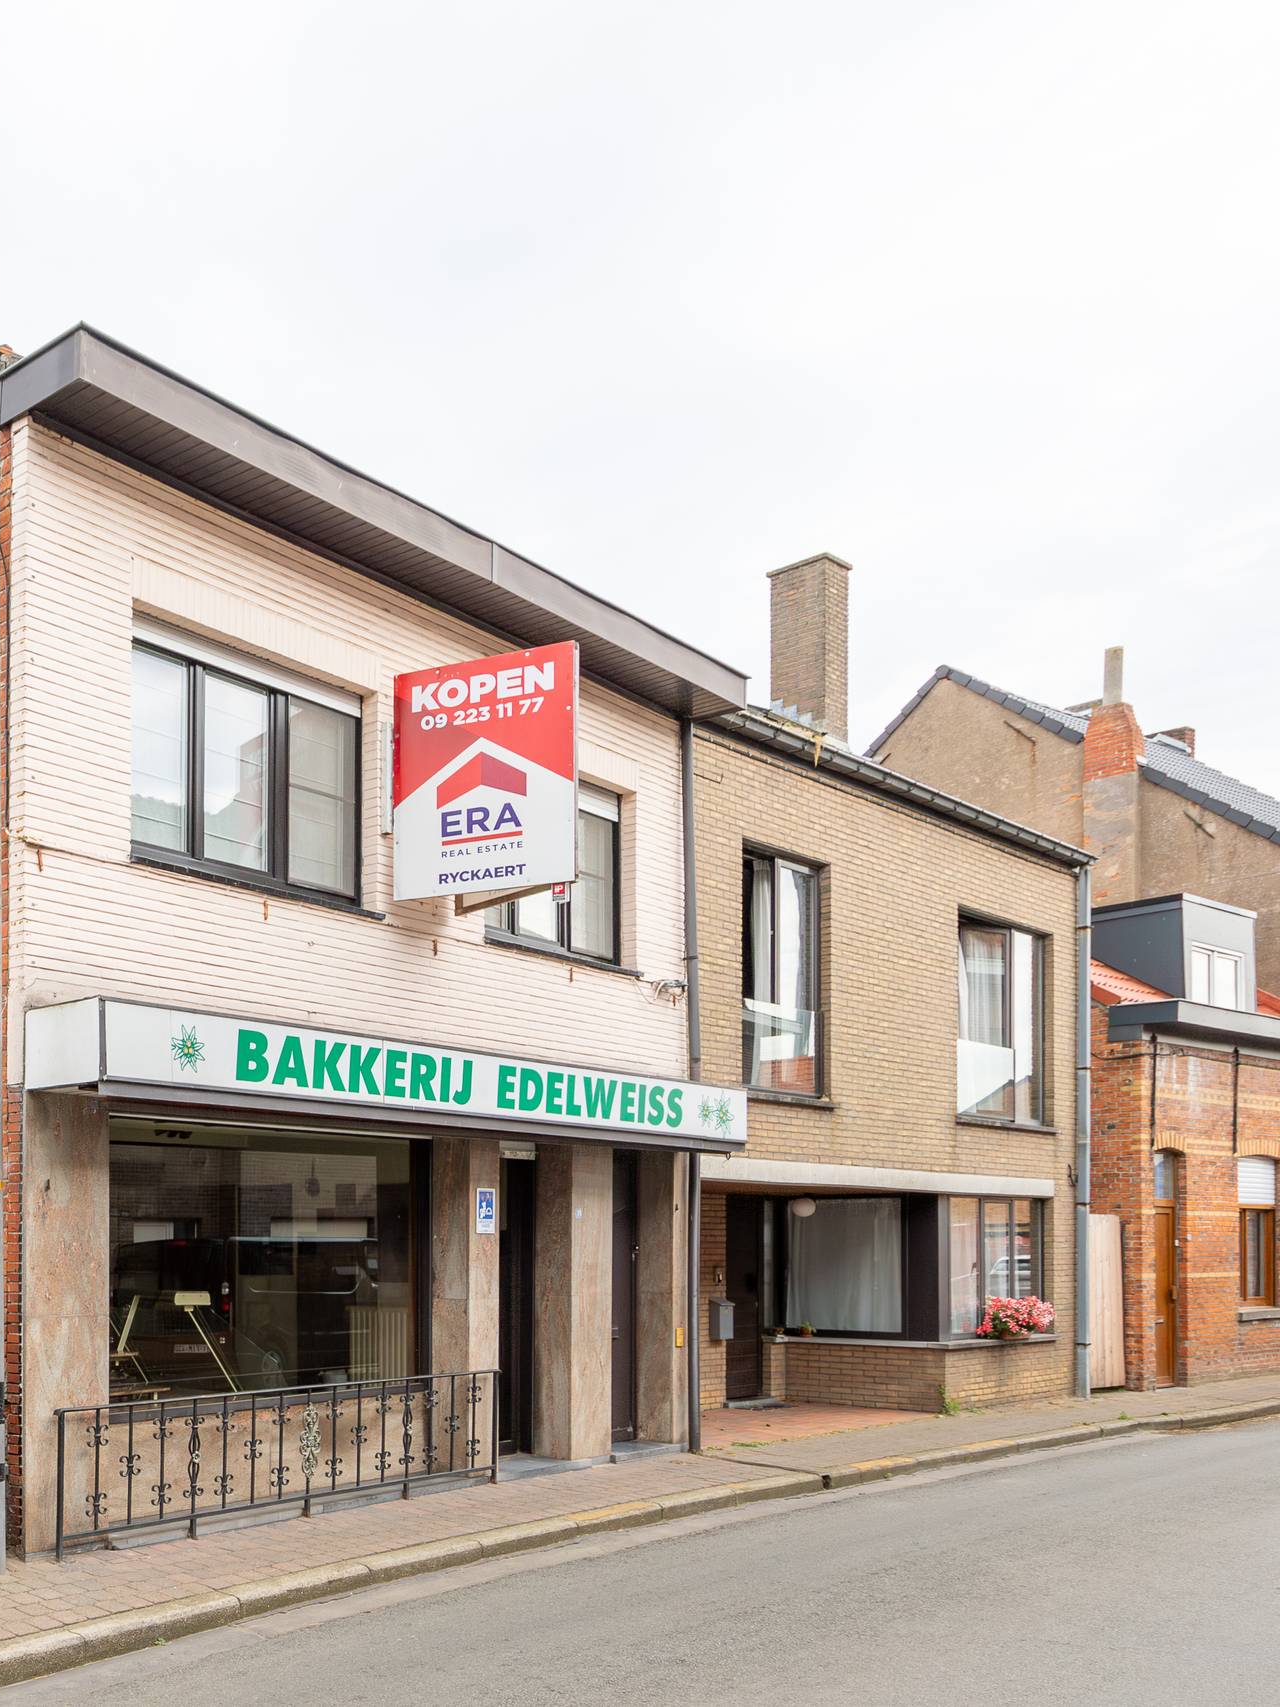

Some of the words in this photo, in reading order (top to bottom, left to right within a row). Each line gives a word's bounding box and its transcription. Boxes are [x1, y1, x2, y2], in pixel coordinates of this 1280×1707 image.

[411, 661, 555, 713] KOPEN
[420, 713, 448, 731] 09
[453, 706, 491, 726] 223
[496, 702, 513, 719] 11
[519, 696, 545, 716] 77
[441, 802, 523, 838] ERA
[441, 848, 471, 859] REAL
[477, 840, 523, 854] ESTATE
[438, 863, 527, 885] RYCKAERT
[236, 1028, 474, 1106] BAKKERIJ
[497, 1064, 684, 1128] EDELWEISS
